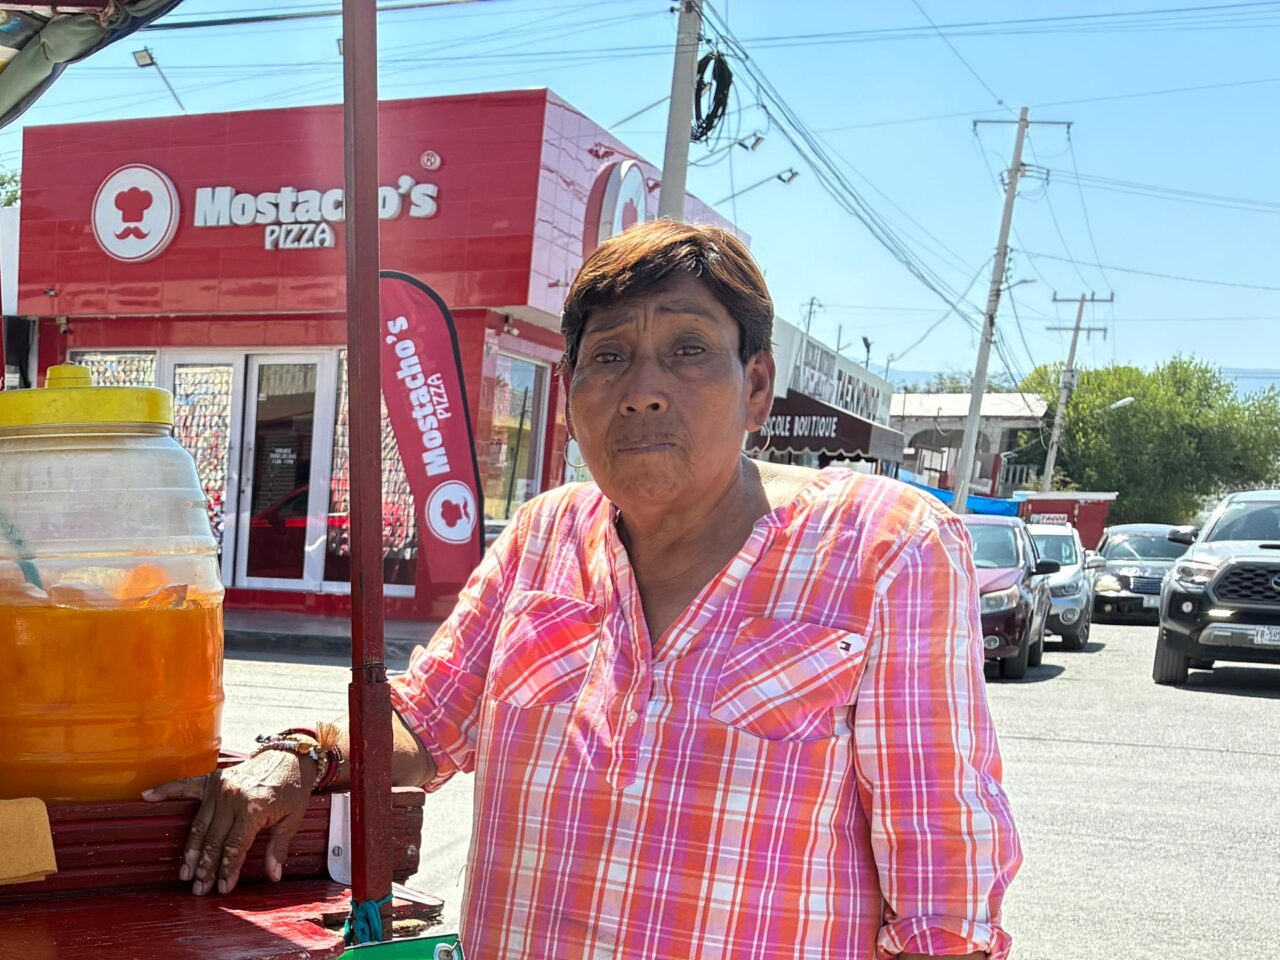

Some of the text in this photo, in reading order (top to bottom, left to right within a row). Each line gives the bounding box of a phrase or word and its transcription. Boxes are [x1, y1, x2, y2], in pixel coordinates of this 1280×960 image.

[194, 174, 439, 227] Mostaco's
[264, 222, 335, 250] PIZZA
[385, 316, 451, 477] Mostacho's
[427, 372, 452, 420] PIZZA
[793, 416, 838, 438] BOUTIQUE
